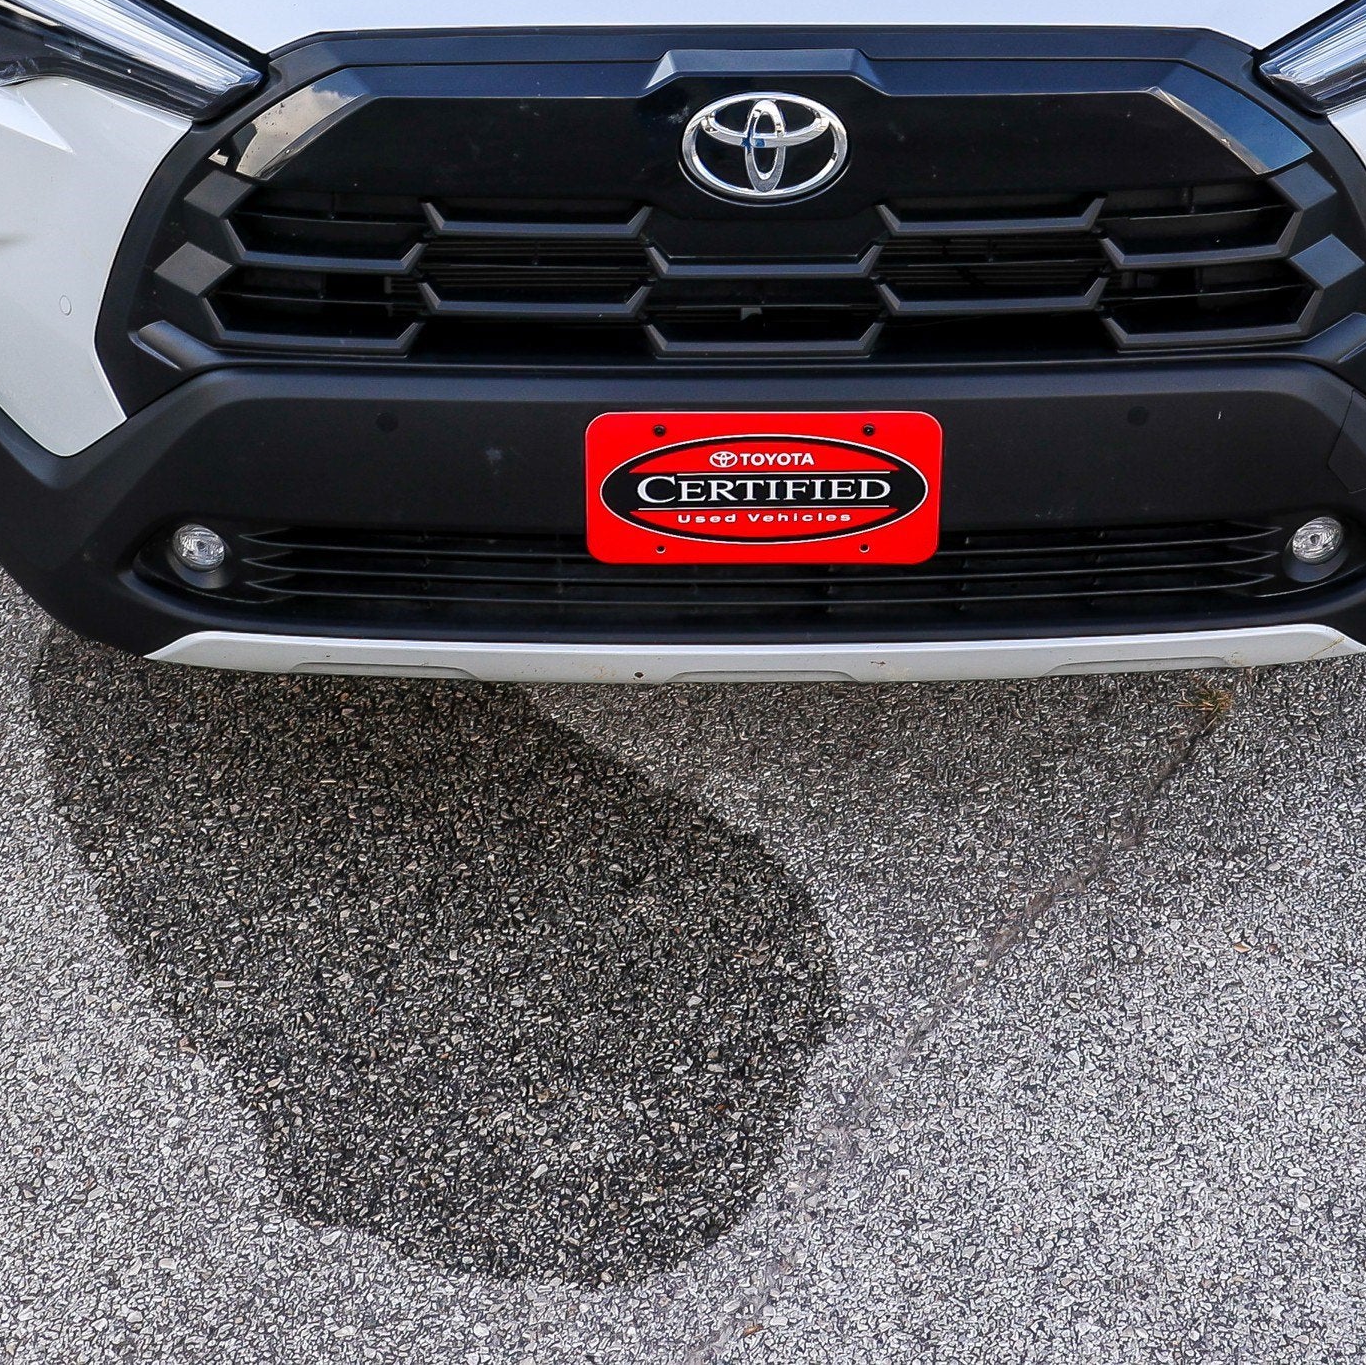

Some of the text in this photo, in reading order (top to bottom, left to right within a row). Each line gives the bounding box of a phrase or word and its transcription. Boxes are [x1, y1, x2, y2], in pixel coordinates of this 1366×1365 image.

[740, 452, 815, 466] TOYOTA
[637, 475, 891, 504] CERTIFIED
[677, 512, 851, 524] Used Vehicles
